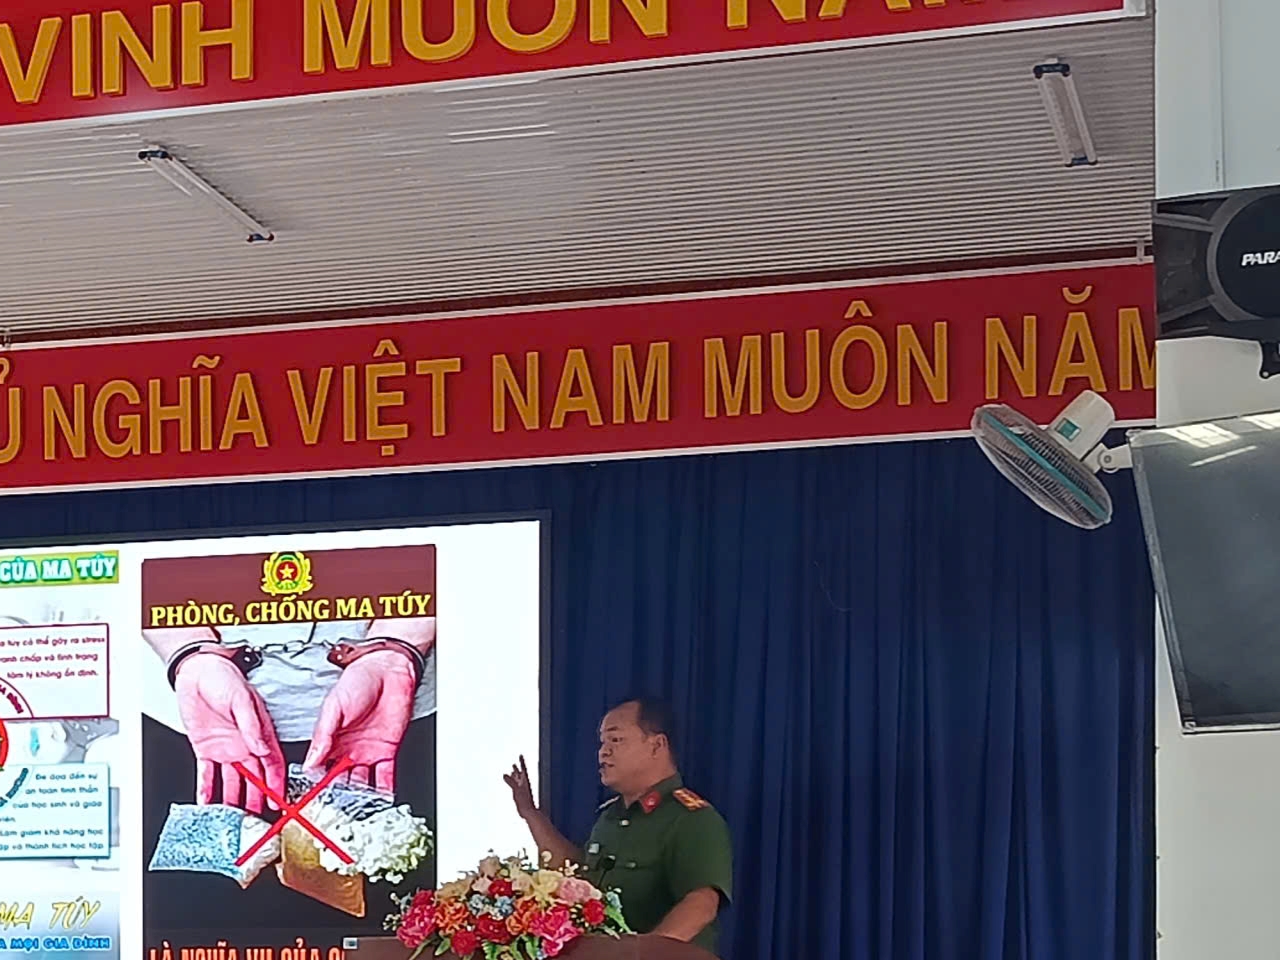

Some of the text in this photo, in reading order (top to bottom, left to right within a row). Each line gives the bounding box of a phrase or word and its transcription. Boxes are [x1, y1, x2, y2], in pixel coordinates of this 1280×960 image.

[44, 355, 269, 461] NGHĨA
[287, 339, 461, 457] VIỆT
[492, 341, 670, 432] NAM
[703, 300, 949, 419] MUÔN
[985, 285, 1156, 400] NĂM
[41, 559, 73, 582] MA
[76, 553, 117, 580] TÚY
[150, 590, 431, 627] PHÒNG, CHỐNG MA TÚY
[48, 895, 101, 929] TÚY
[43, 937, 70, 950] GIA
